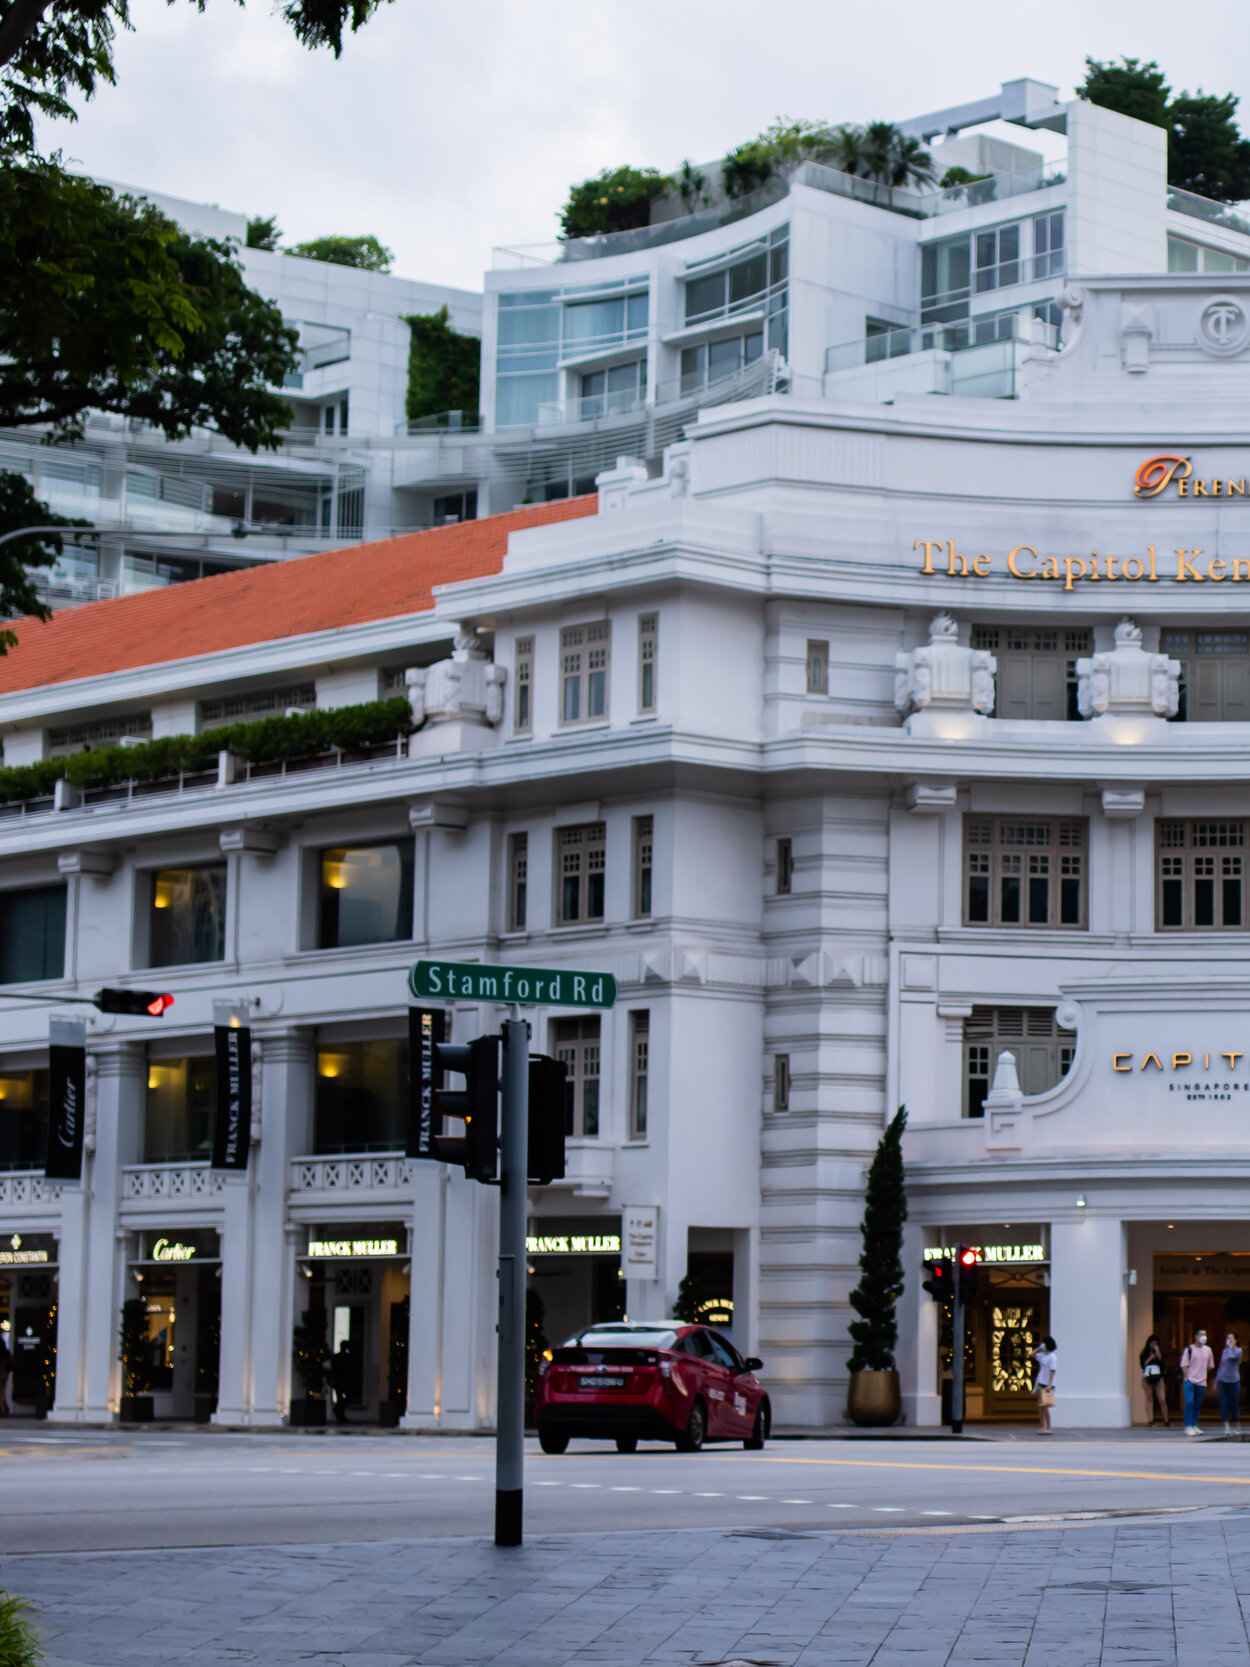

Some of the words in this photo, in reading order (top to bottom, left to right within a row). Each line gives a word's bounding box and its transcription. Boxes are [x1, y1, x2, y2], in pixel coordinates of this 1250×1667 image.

[914, 540, 991, 577] The
[1007, 545, 1160, 591] Capitol
[428, 966, 561, 1000] Stamford
[573, 976, 604, 1003] Rd
[227, 1032, 240, 1094] MULLER
[421, 1013, 433, 1080] MULLER
[1169, 1083, 1250, 1091] SINGAPORE
[57, 1076, 77, 1148] Cartier
[225, 1100, 240, 1163] FRANCK
[419, 1086, 432, 1152] FRANCK
[153, 1238, 196, 1261] Cartier
[308, 1241, 351, 1257] FRANCK
[352, 1240, 397, 1256] MULLER
[571, 1236, 621, 1252] MULLER
[984, 1245, 1044, 1261] MULLER
